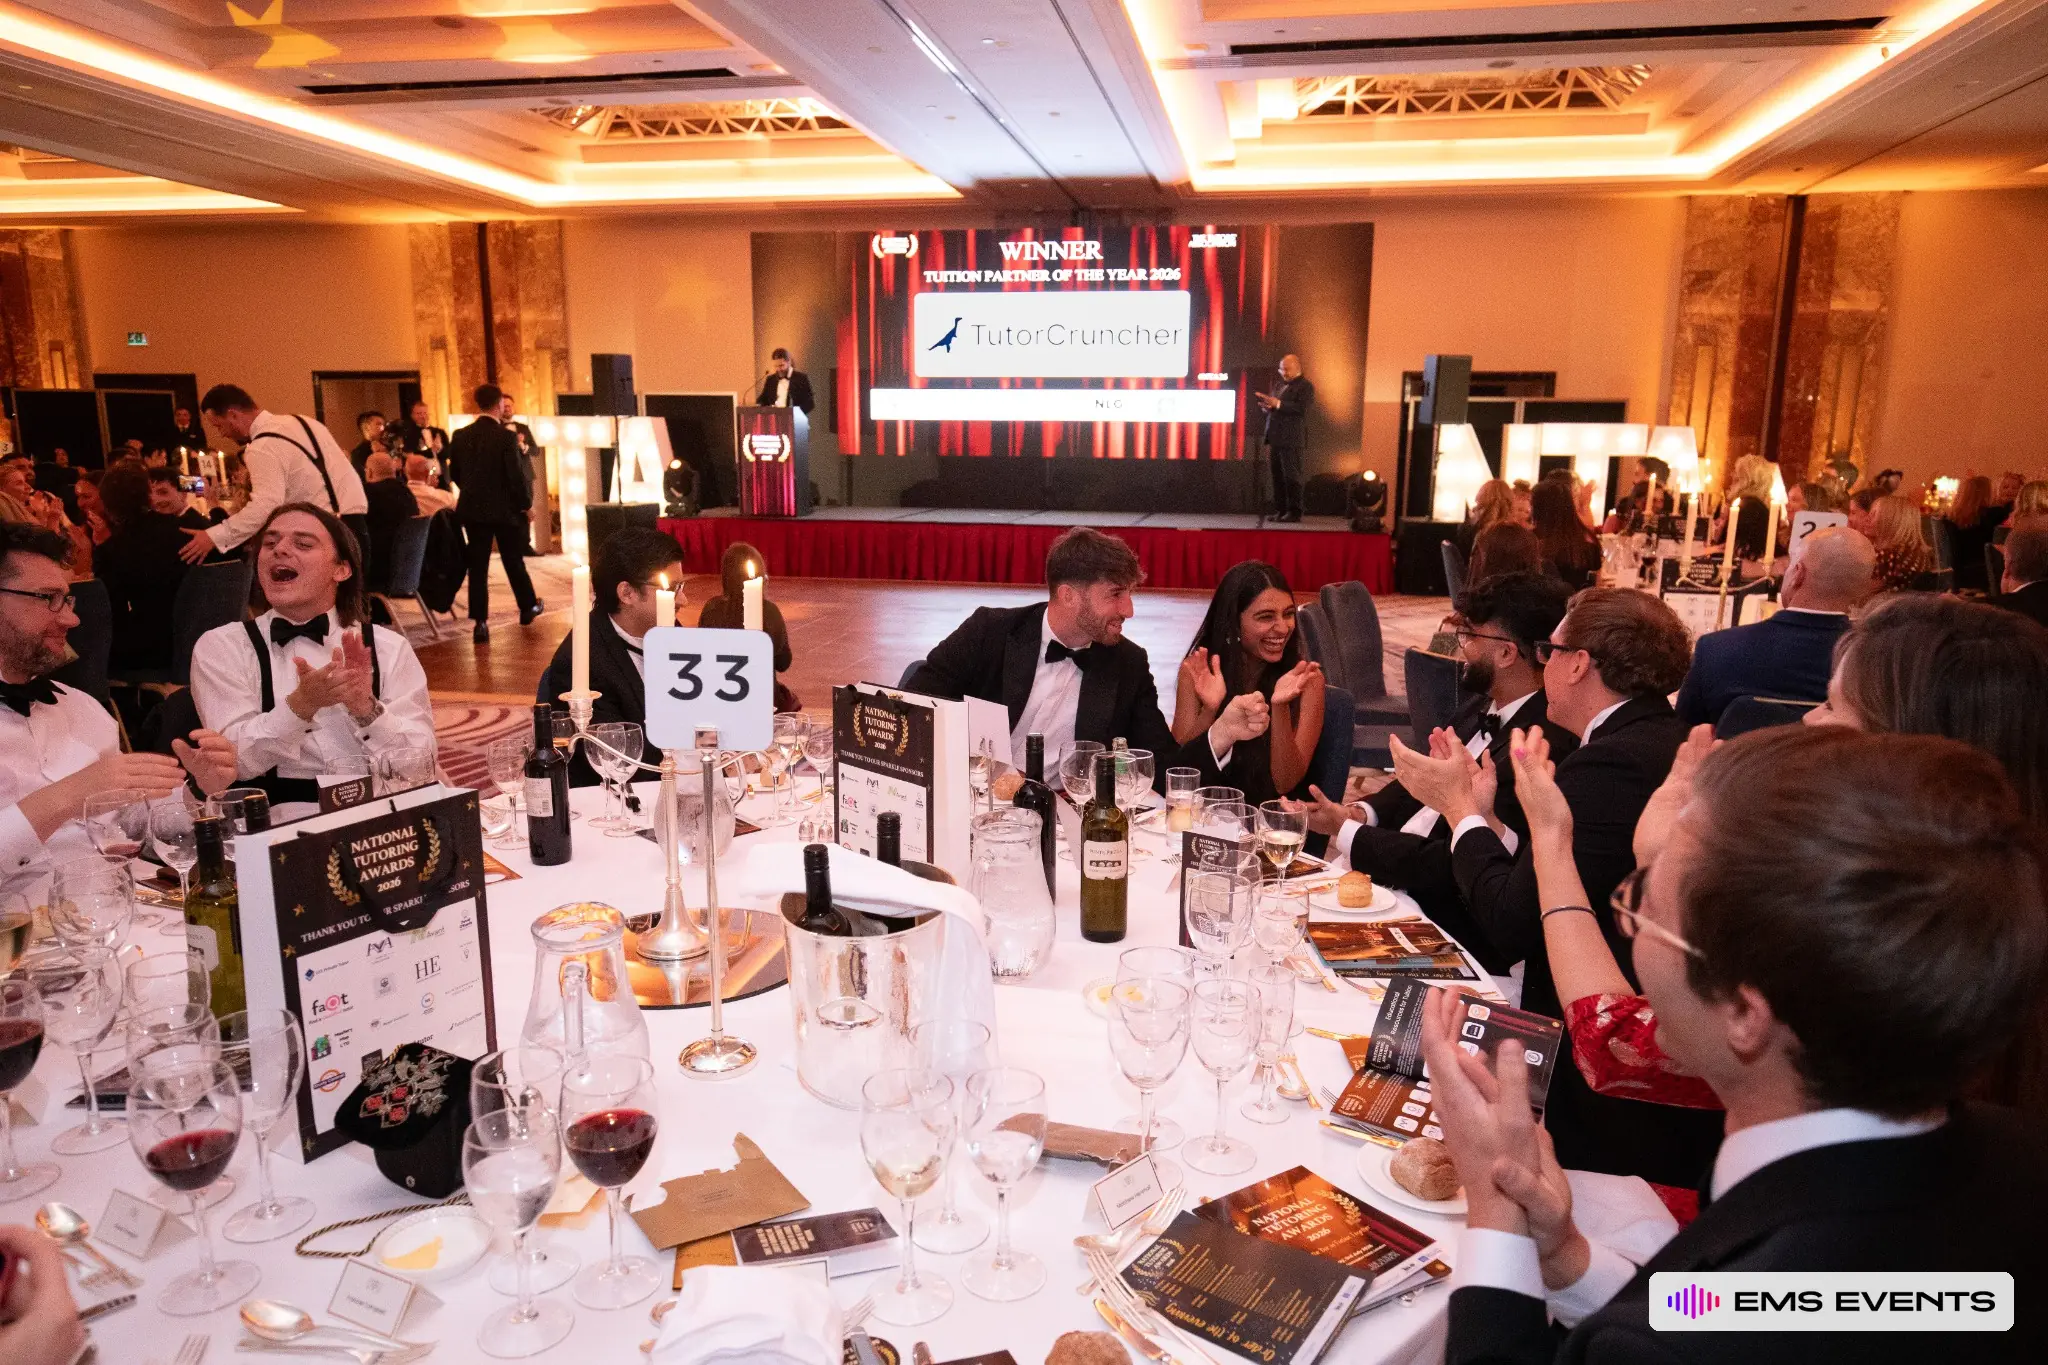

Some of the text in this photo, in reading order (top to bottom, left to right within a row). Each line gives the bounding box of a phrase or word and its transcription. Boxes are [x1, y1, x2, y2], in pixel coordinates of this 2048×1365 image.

[999, 240, 1104, 261] WINNER
[923, 267, 1182, 283] TUITION PARTNER OF THE YEAR 2026
[971, 323, 1183, 346] TutorCruncher
[667, 652, 750, 702] 33
[864, 705, 898, 721] NATIONAL
[864, 716, 898, 732] TUTORING
[866, 727, 895, 742] AWARDS
[350, 825, 417, 854] NATIONAL
[353, 840, 419, 869] TUTORING
[359, 856, 415, 883] AWARDS
[376, 876, 402, 893] 2026
[300, 924, 336, 944] THANK
[336, 918, 358, 931] YOU
[414, 954, 442, 980] HE
[1384, 991, 1401, 1021] Educational
[1251, 1197, 1316, 1227] NATIONAL
[1261, 1203, 1328, 1234] TUTORING
[1281, 1213, 1334, 1241] AWARDS
[1306, 1227, 1331, 1242] 2026
[1165, 1302, 1207, 1329] evening
